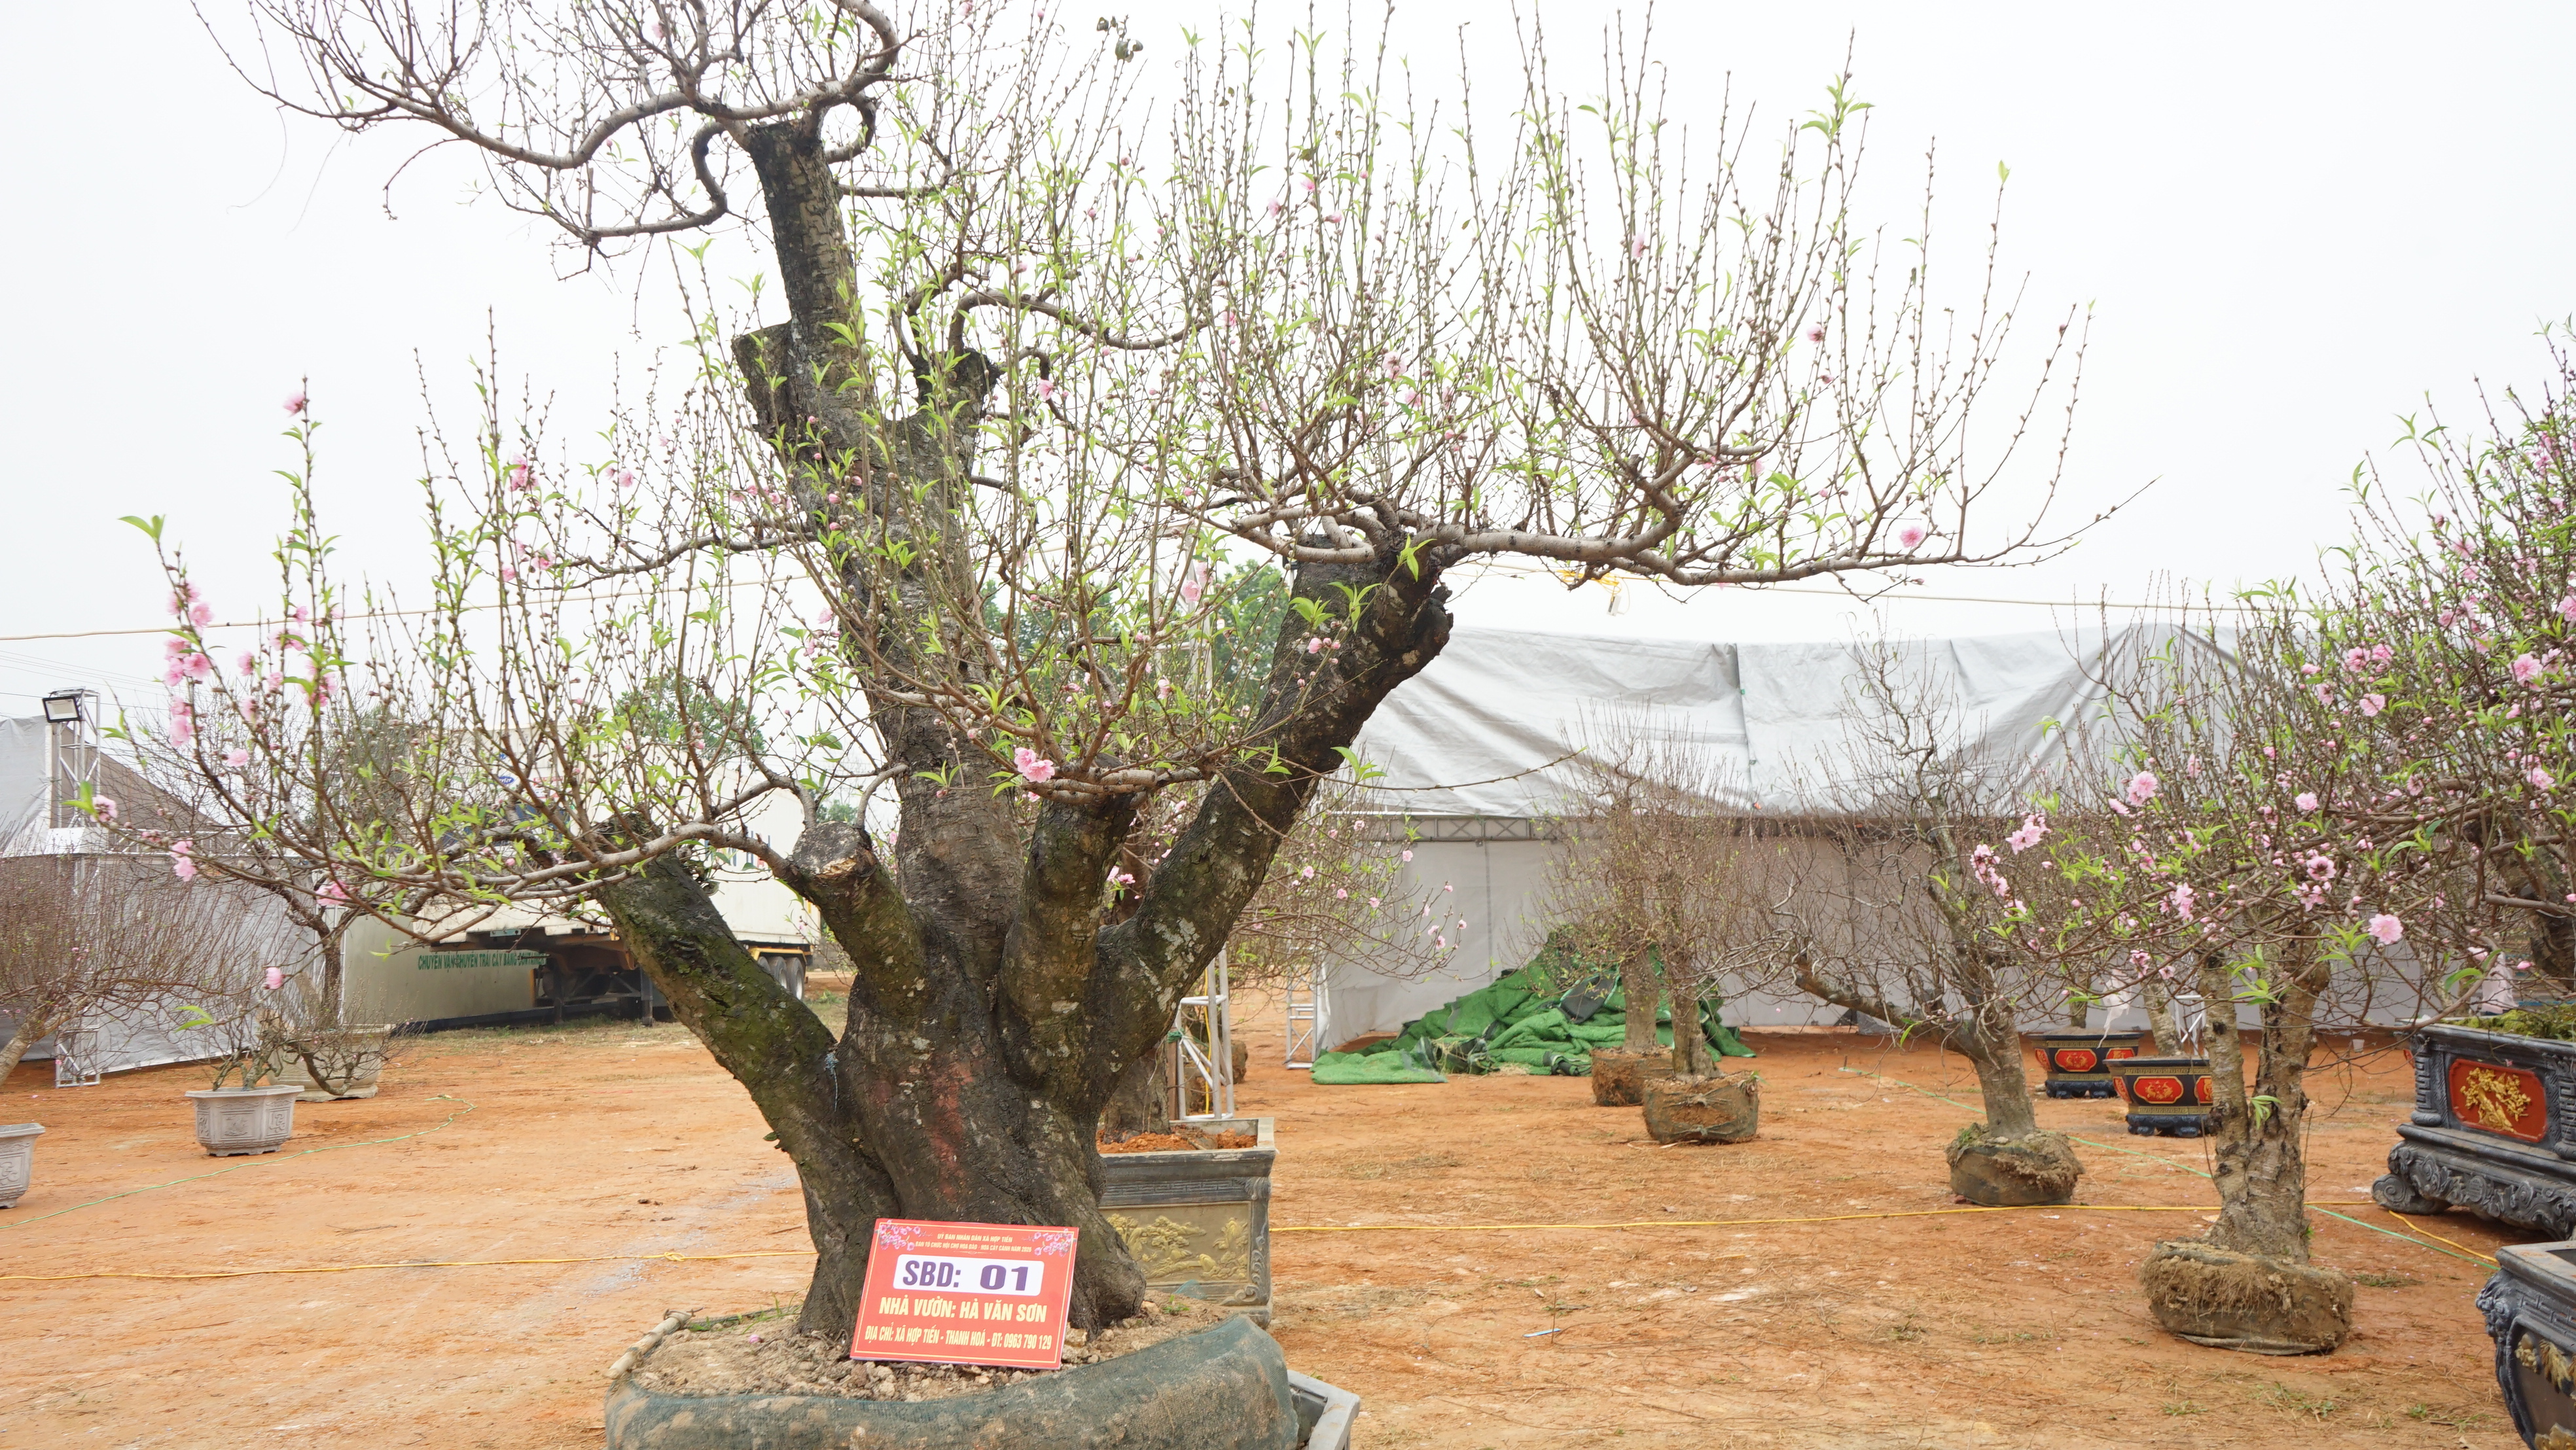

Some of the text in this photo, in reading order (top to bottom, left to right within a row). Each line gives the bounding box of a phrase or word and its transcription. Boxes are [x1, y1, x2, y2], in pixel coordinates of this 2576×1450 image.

[903, 1260, 1029, 1291] SBD: 01
[879, 1294, 1047, 1322] NHÀ VƯỜN: HÀ VĂN SƠN
[865, 1325, 878, 1343] ĐỊA
[878, 1322, 895, 1341] CHỈ:
[895, 1324, 906, 1342] XÃ
[906, 1326, 922, 1346] HỢP
[923, 1324, 940, 1344] TIẾN
[945, 1330, 970, 1346] THANH
[970, 1329, 986, 1347] HOÁ
[991, 1332, 1003, 1347] ĐT:
[1003, 1333, 1022, 1349] 0963
[1023, 1334, 1037, 1349] 790
[1038, 1334, 1052, 1350] 129
